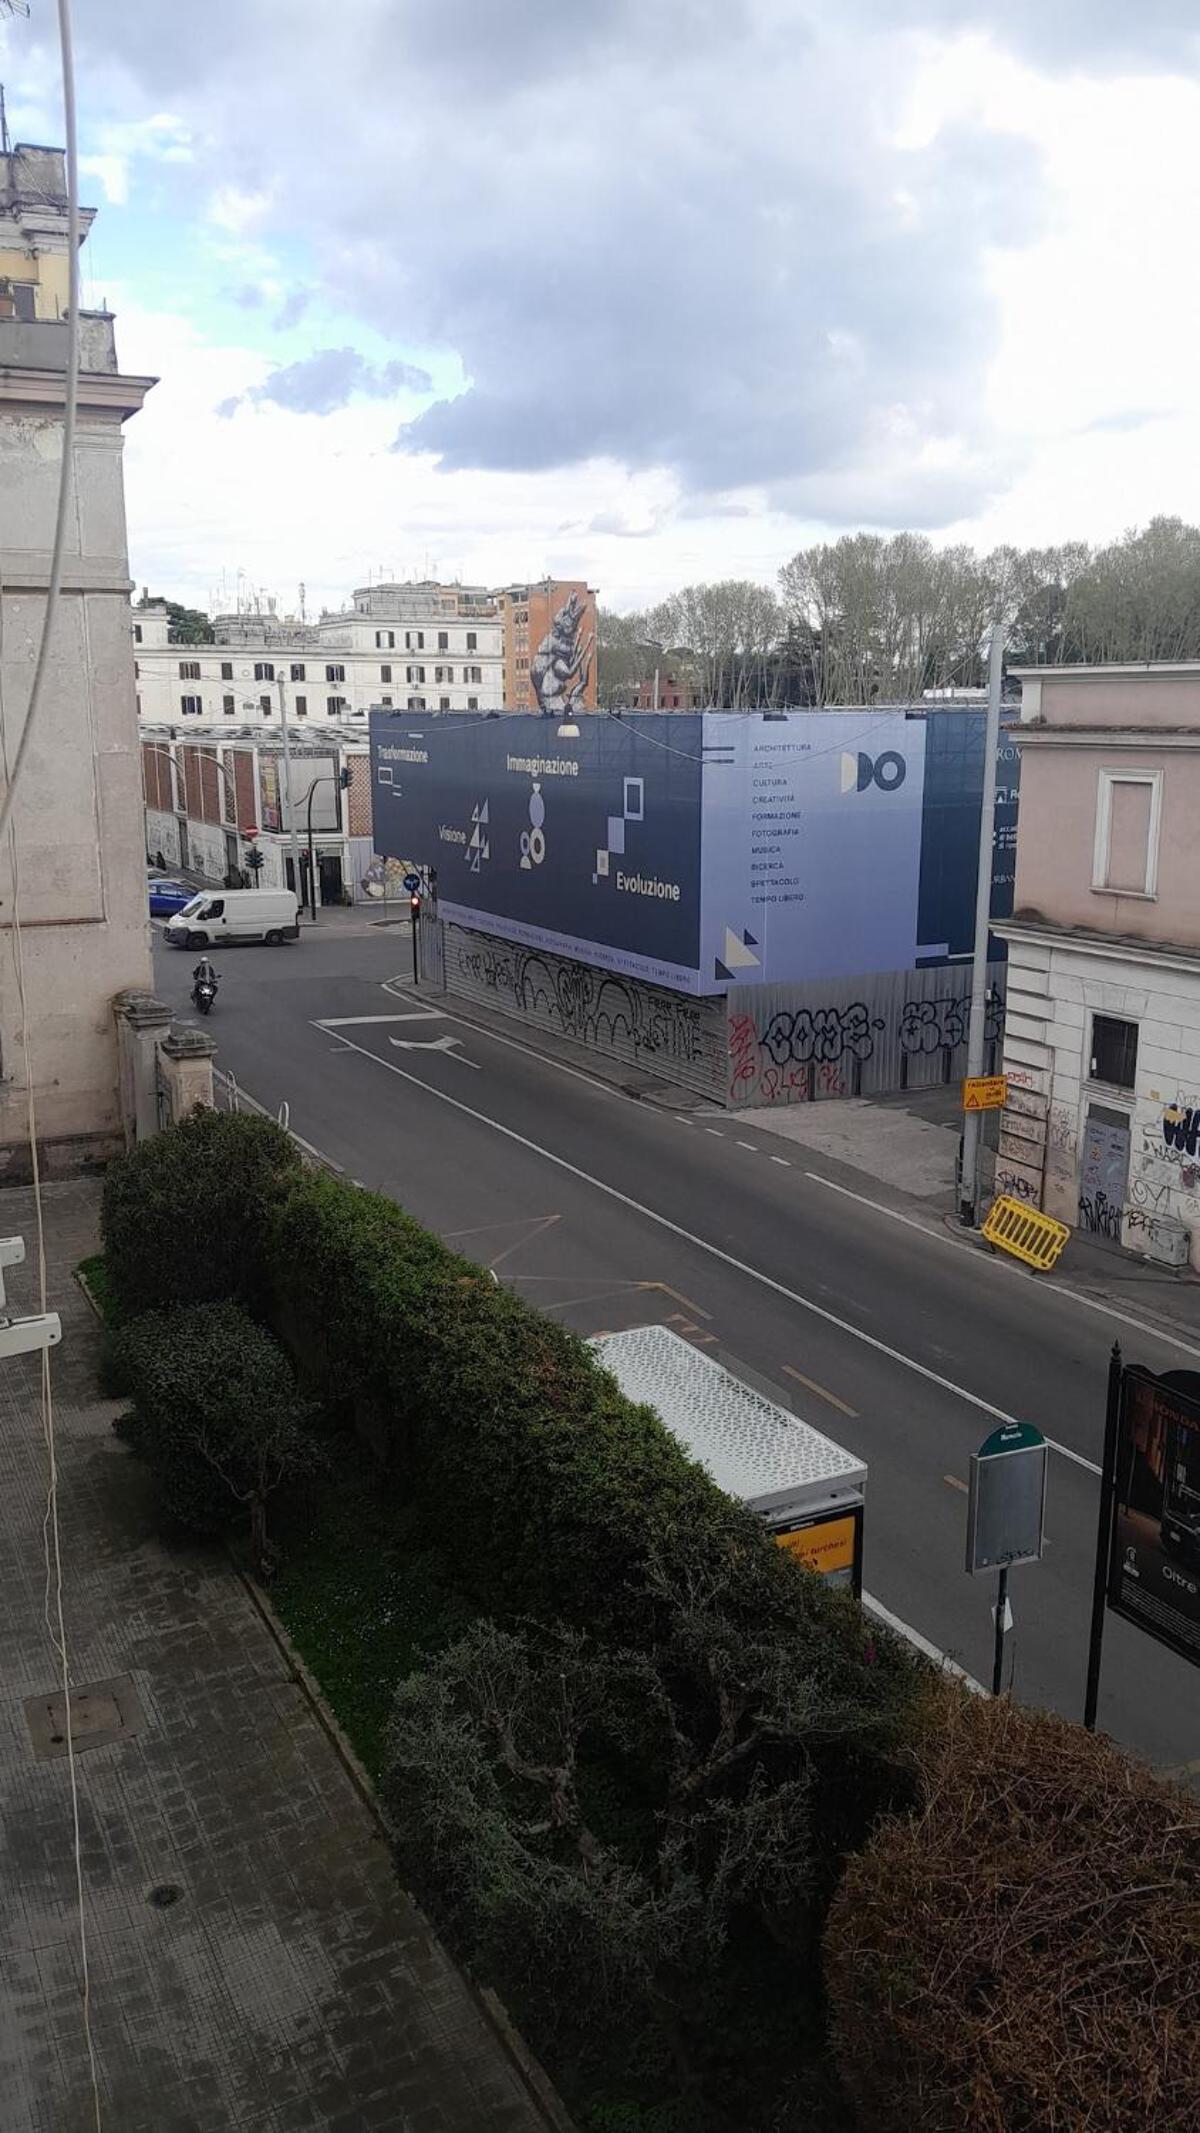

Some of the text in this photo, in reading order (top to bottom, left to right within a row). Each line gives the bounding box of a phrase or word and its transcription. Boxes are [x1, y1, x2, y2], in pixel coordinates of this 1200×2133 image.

[753, 744, 812, 752] ARCHITETTURA
[377, 745, 428, 764] Trasformazione
[506, 754, 579, 777] Immaginazione
[752, 779, 787, 787] CULTURA
[752, 812, 801, 821] FORMAZIONE
[438, 823, 466, 844] Visione
[751, 829, 799, 838] FOTOGRAFIA
[751, 846, 781, 855] MUSICA
[751, 862, 784, 871] RICERCA
[616, 871, 681, 901] Evoluzione
[750, 879, 799, 888] SPETTACOLO
[751, 893, 804, 903] TEMPO LIBERO
[1162, 1565, 1198, 1595] Oltre
